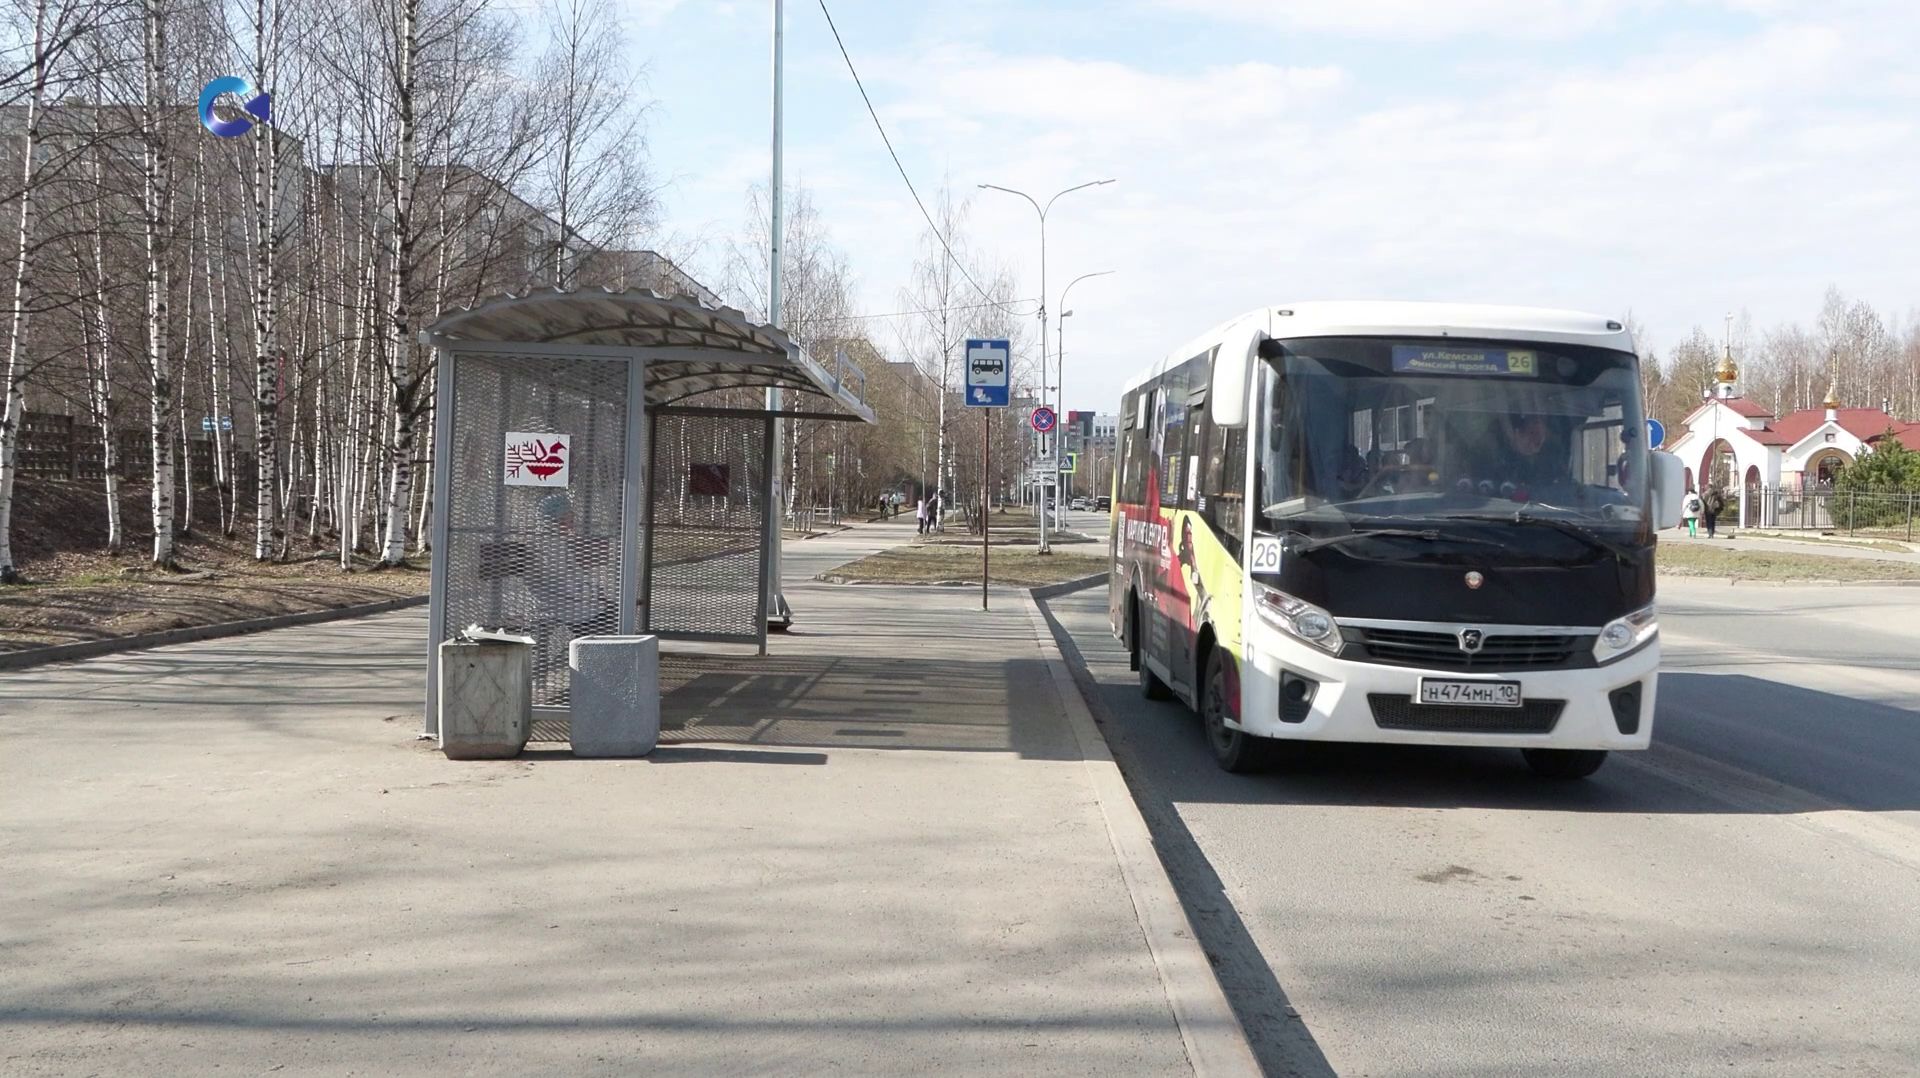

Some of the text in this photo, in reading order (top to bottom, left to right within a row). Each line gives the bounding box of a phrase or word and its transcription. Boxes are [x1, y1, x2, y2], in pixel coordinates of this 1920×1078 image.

[1409, 358, 1498, 372] Финский проезд
[1509, 356, 1530, 369] 26
[1254, 543, 1278, 567] 26
[1428, 684, 1513, 701] Н474МН 10
